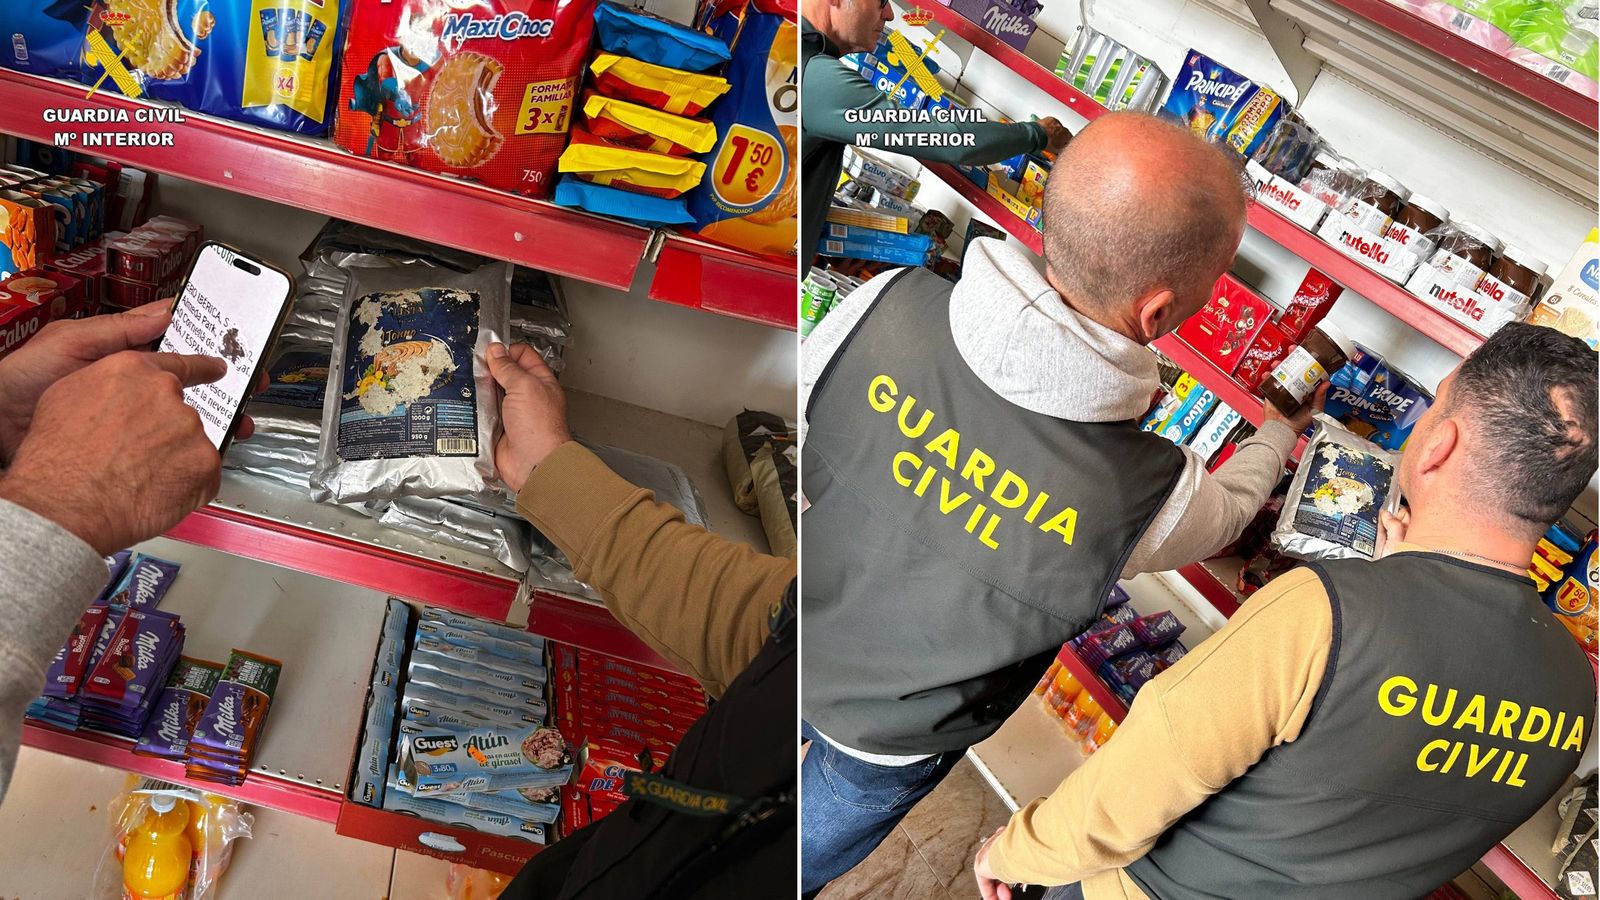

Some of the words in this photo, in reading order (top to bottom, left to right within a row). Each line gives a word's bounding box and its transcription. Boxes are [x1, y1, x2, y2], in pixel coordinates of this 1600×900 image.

[982, 6, 1031, 36] Milka
[877, 77, 907, 98] ORO
[863, 162, 887, 178] Calvo
[880, 198, 903, 212] Calvo
[1338, 229, 1390, 265] nutella
[1429, 280, 1487, 322] nutella
[207, 397, 233, 420] nevera
[1183, 389, 1214, 427] Calvo
[868, 374, 1079, 546] GUARDIA
[893, 451, 1002, 551] CIVIL
[135, 564, 164, 605] Milka
[135, 631, 160, 671] Milka
[158, 701, 181, 741] Milka
[213, 694, 237, 737] Milka
[1377, 675, 1585, 752] GUARDIA
[414, 736, 458, 750] Guest
[463, 732, 509, 758] Atún
[491, 757, 521, 769] girasol
[1416, 738, 1529, 788] CIVIL
[648, 780, 701, 809] GUARDIA
